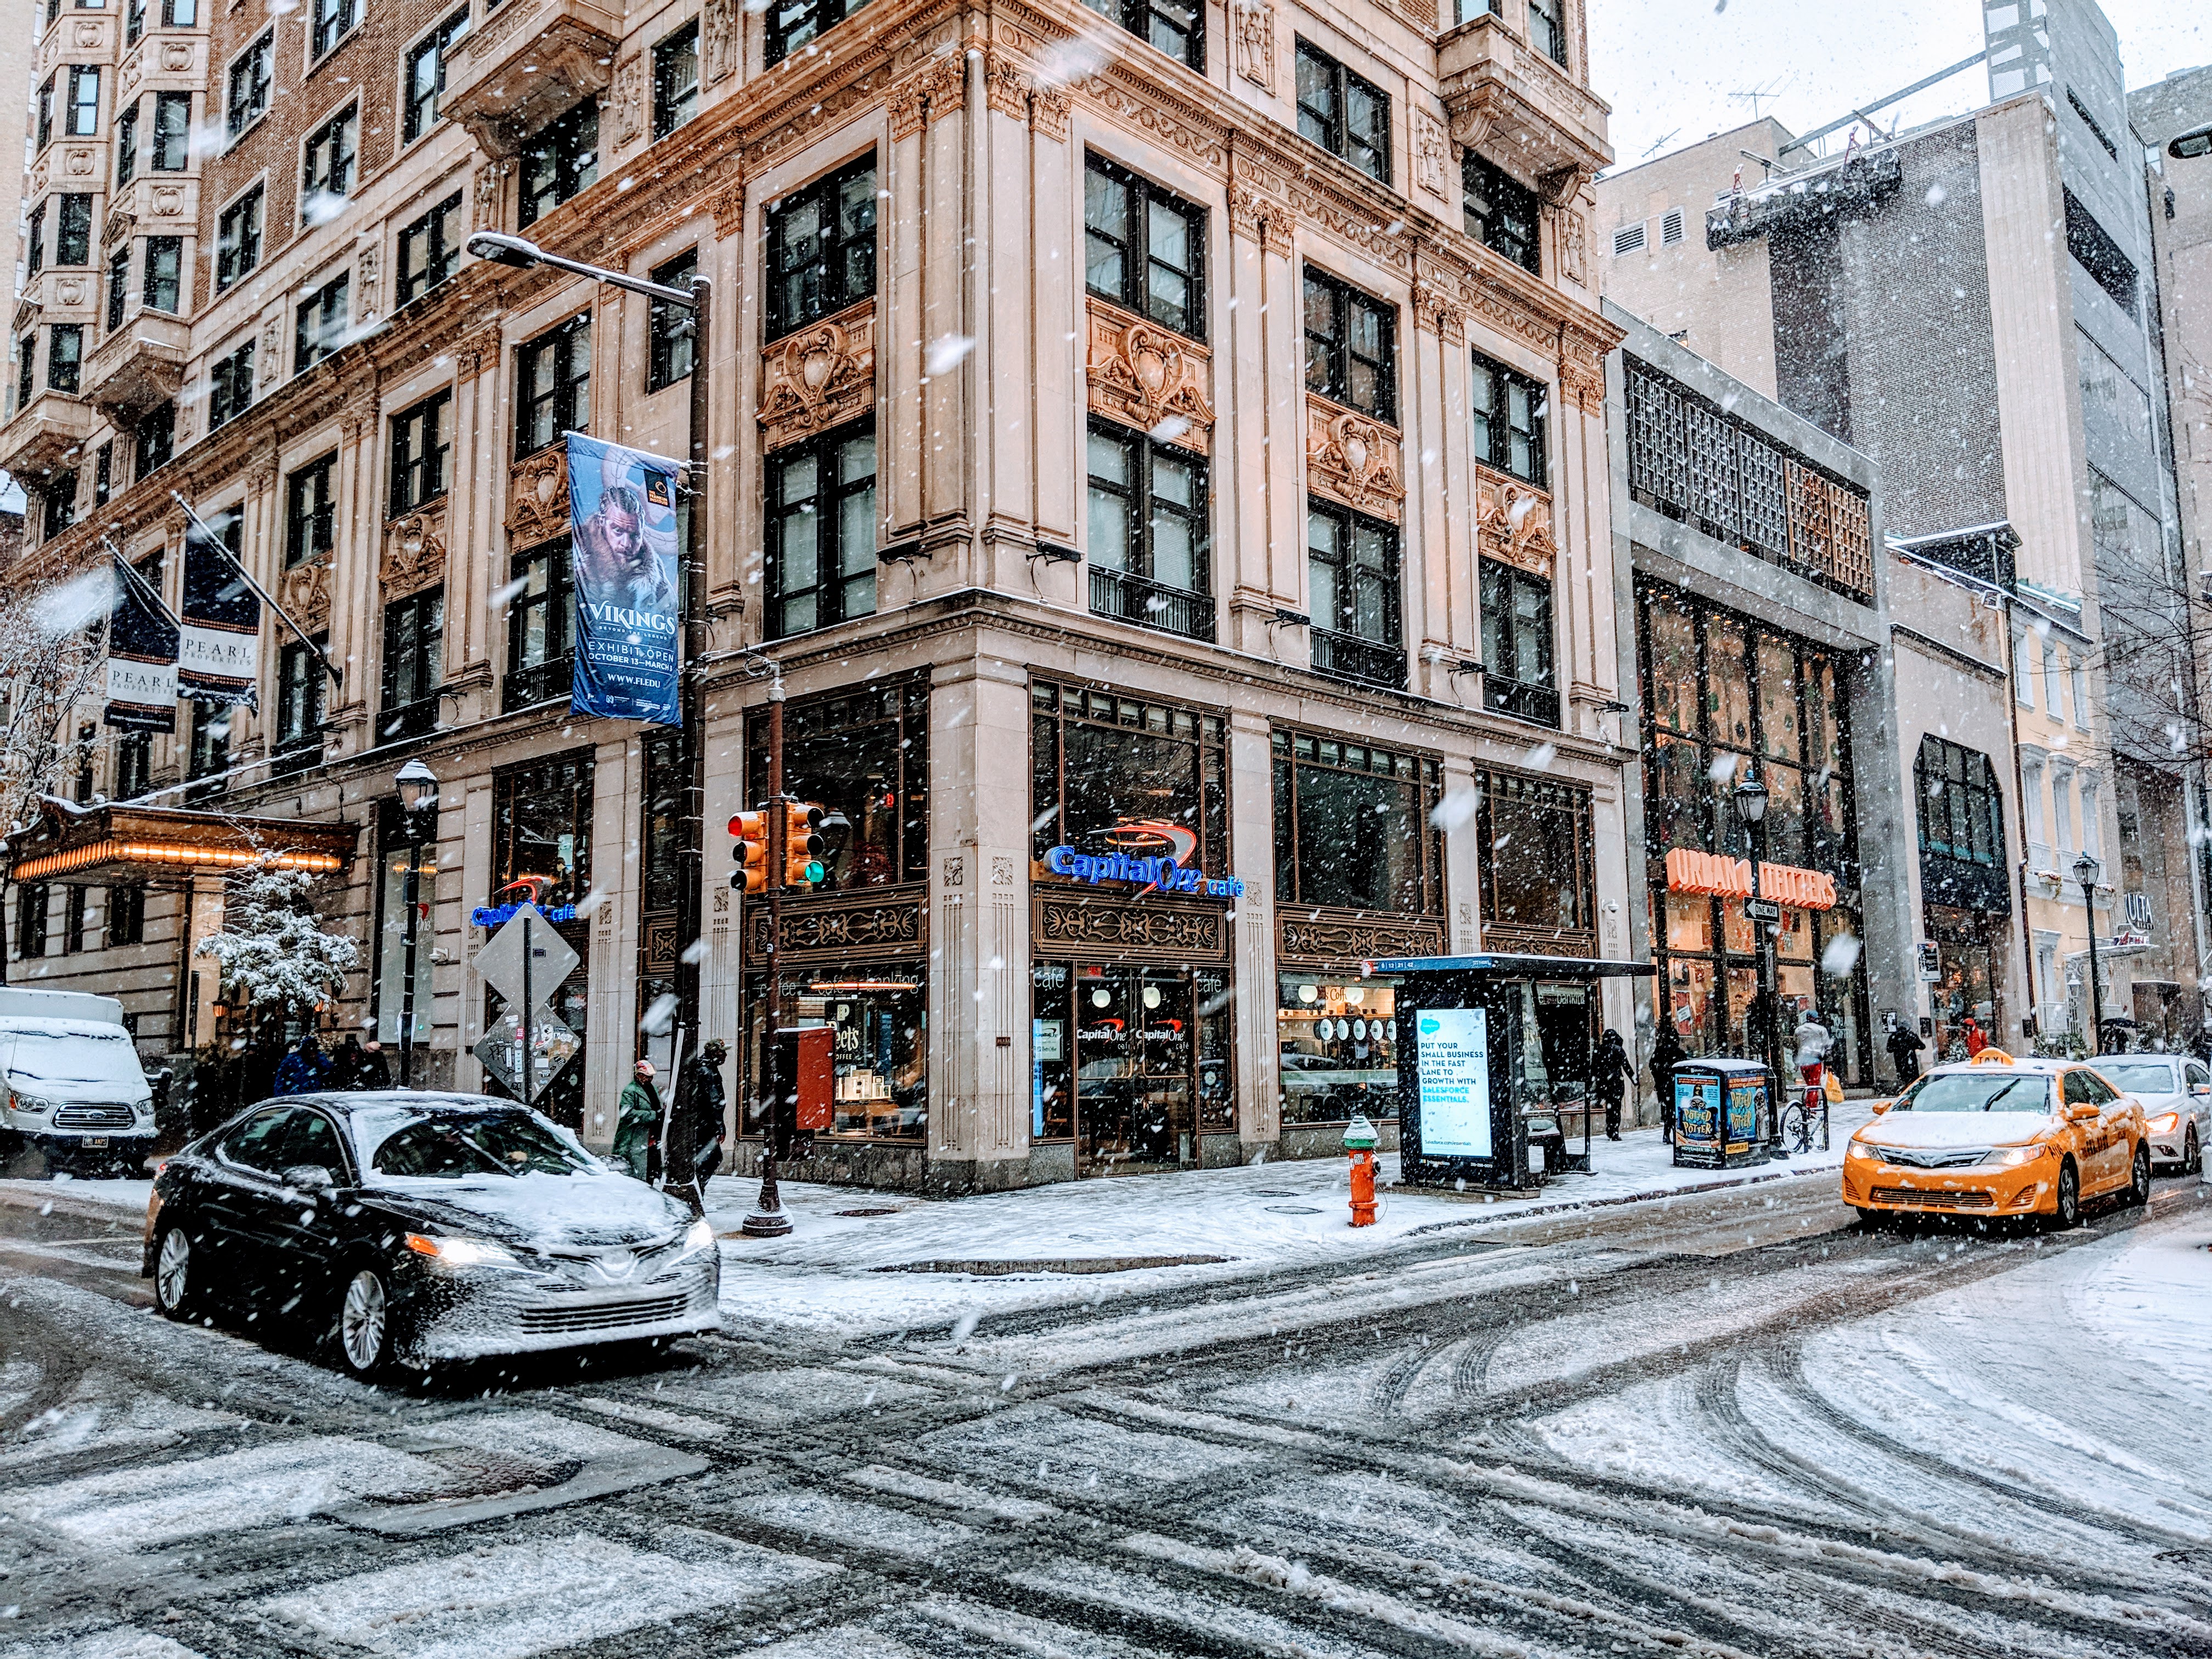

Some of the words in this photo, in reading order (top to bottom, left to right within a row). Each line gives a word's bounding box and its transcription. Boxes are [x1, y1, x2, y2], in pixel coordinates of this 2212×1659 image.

[589, 600, 675, 635] VIKINGS
[644, 632, 667, 640] LEGEND
[184, 651, 252, 667] PROPERTIES
[589, 641, 641, 657] EXHIBIT
[647, 649, 674, 663] OPEN
[589, 652, 629, 664] OCTOBER
[607, 673, 661, 689] WWW.FI.EDU
[1669, 847, 1738, 891] URBAN
[1208, 876, 1244, 897] café
[1755, 904, 1765, 913] ONE
[1767, 906, 1776, 916] WAY
[2127, 893, 2153, 923] ULTA
[1033, 968, 1065, 988] café
[1196, 974, 1222, 993] café
[1730, 1090, 1752, 1109] POTTED
[1684, 1108, 1712, 1122] POTTED
[1730, 1110, 1752, 1136] POTTER
[1682, 1121, 1712, 1136] POTTER
